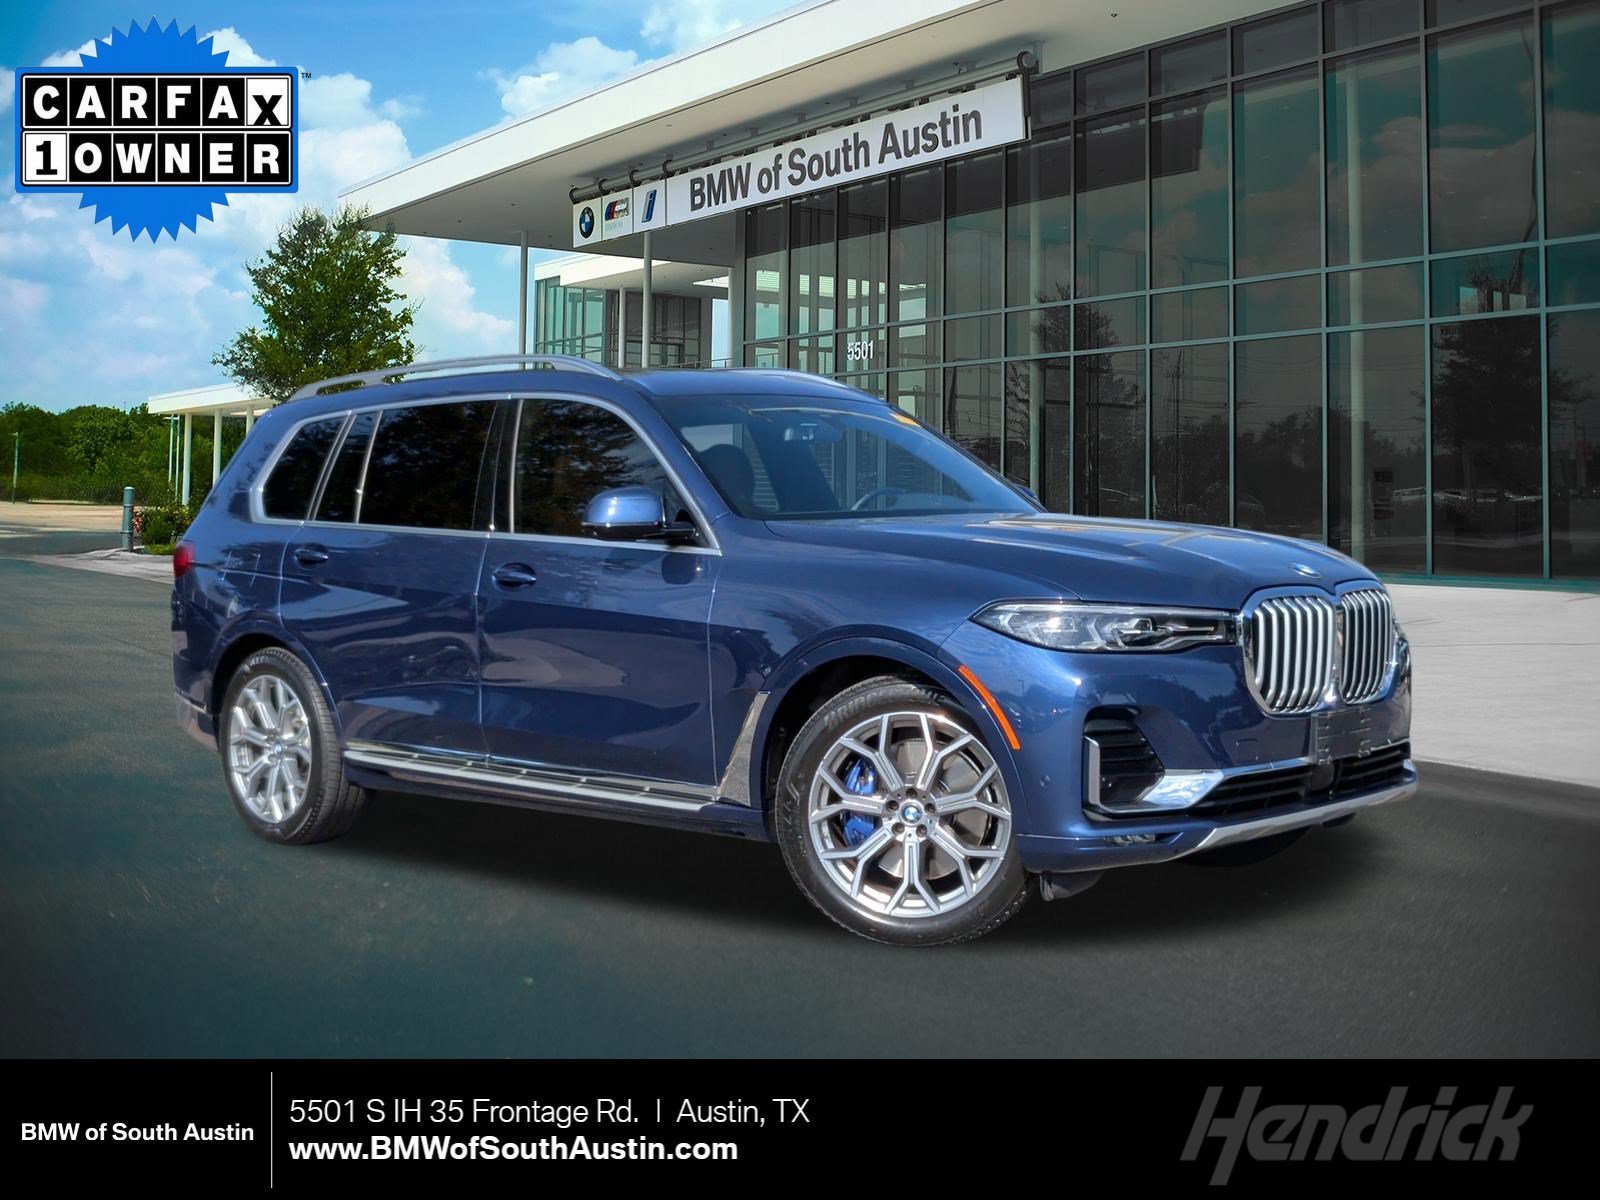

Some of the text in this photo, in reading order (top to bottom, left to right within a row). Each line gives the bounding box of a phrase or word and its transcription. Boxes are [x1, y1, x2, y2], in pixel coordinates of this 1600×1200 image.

[690, 104, 982, 212] BMW of South Austin
[847, 340, 873, 360] 5501
